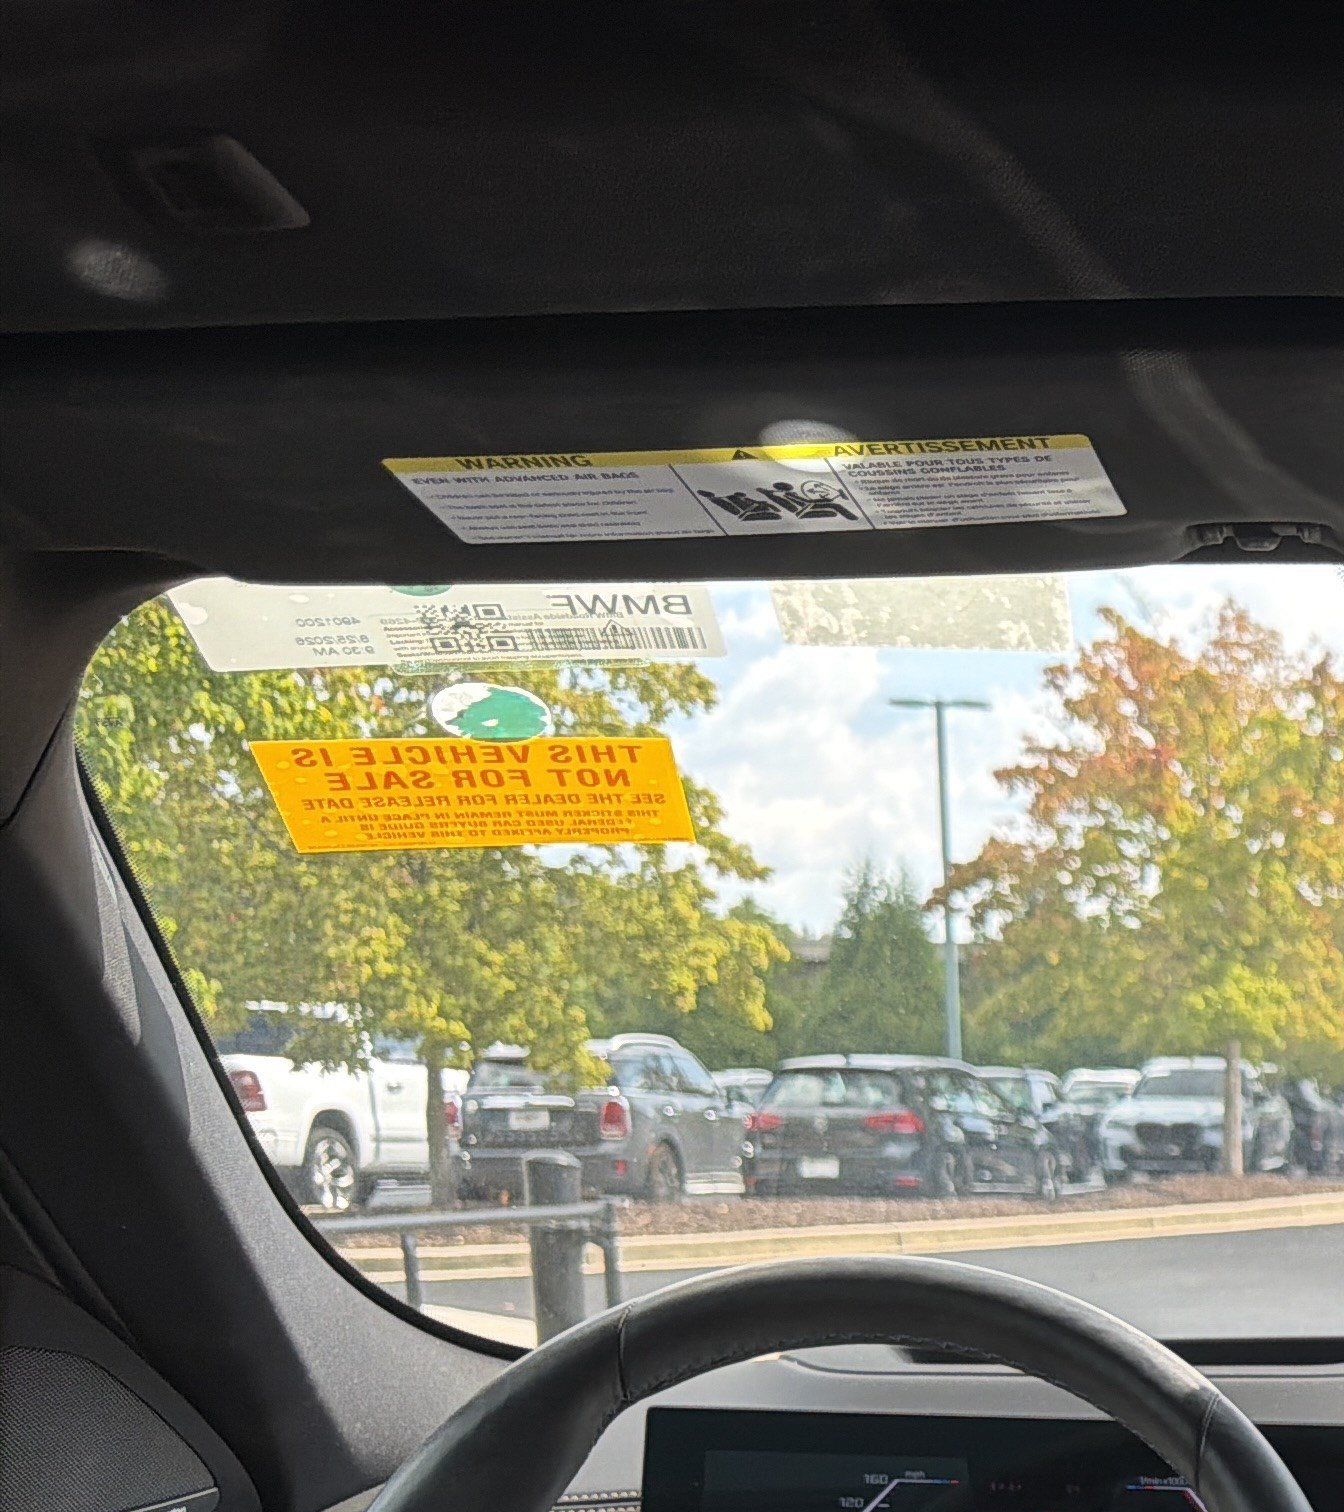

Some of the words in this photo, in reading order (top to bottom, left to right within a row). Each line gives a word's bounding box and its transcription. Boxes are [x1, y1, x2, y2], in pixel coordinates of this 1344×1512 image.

[833, 437, 1051, 458] AVERTISSEMENT
[454, 454, 593, 470] WARNING
[842, 460, 902, 470] VALABLE
[905, 459, 943, 468] POUR
[948, 457, 984, 466] TOUS
[988, 455, 1030, 464] TYPES
[1034, 454, 1052, 463] DE
[411, 476, 449, 485] EVEN
[452, 475, 490, 485] WITH
[495, 473, 569, 484] ADVANCED
[574, 472, 597, 481] AIR
[601, 471, 639, 480] BAGS
[864, 1473, 888, 1485] 160
[839, 1497, 864, 1508] 120
